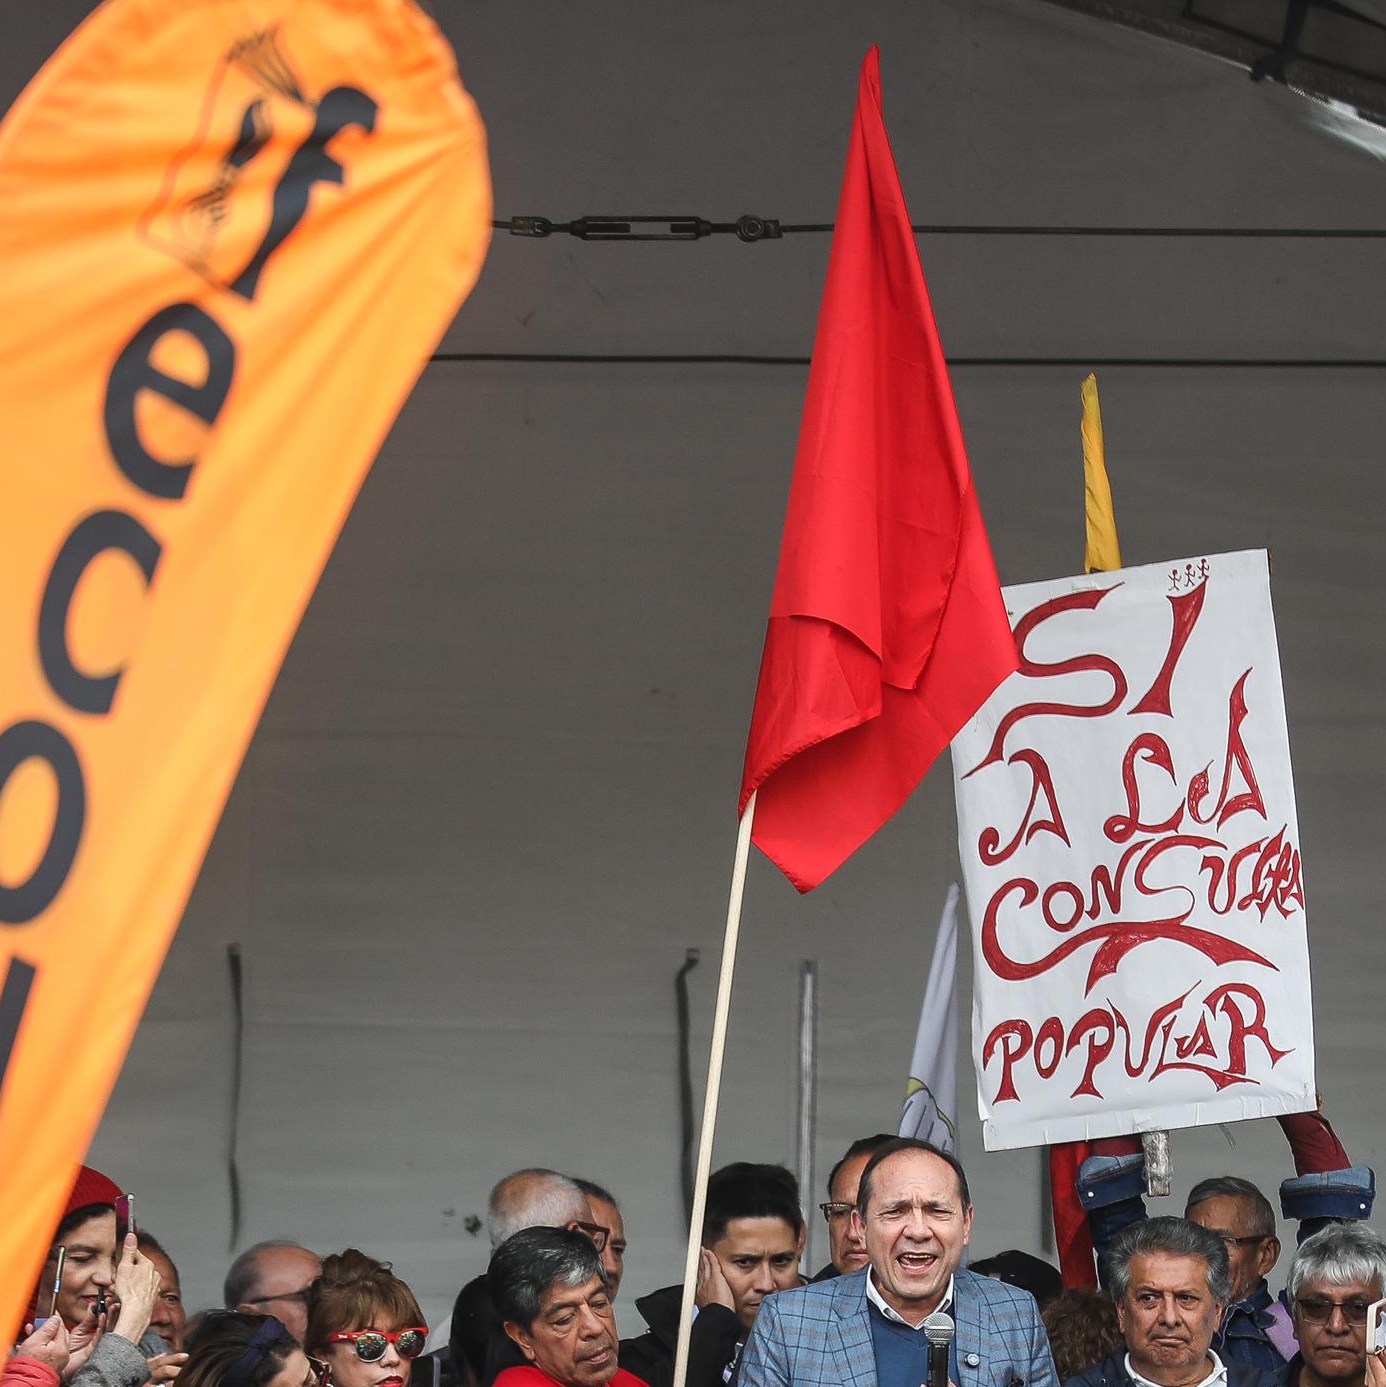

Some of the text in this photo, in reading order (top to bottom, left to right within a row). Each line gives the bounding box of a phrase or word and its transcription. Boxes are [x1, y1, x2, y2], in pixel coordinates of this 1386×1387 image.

[961, 576, 1208, 780] SI
[979, 748, 1071, 867] A
[983, 980, 1295, 1106] POPULAR
